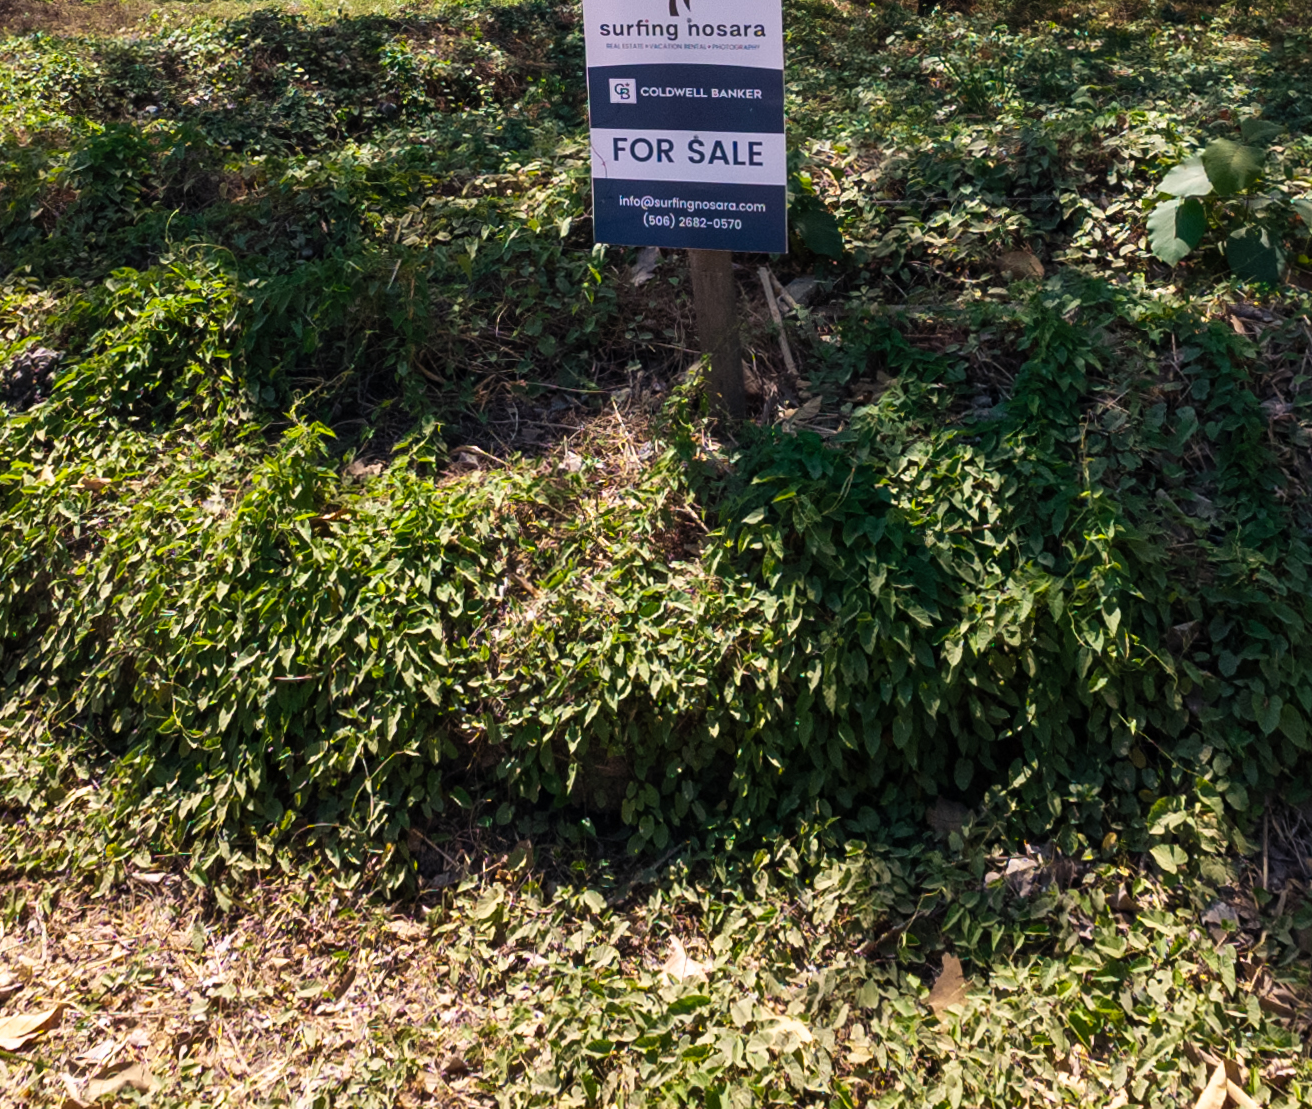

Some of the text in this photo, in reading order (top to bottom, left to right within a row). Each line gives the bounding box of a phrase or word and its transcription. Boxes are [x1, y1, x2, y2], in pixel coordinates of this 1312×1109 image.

[599, 19, 766, 41] surfing nosara
[640, 86, 763, 100] COLDWELL BANKER
[612, 137, 764, 167] FOR SALE
[619, 195, 766, 213] info@surfingnosara.com
[643, 212, 742, 230] (506) 2682-0570
